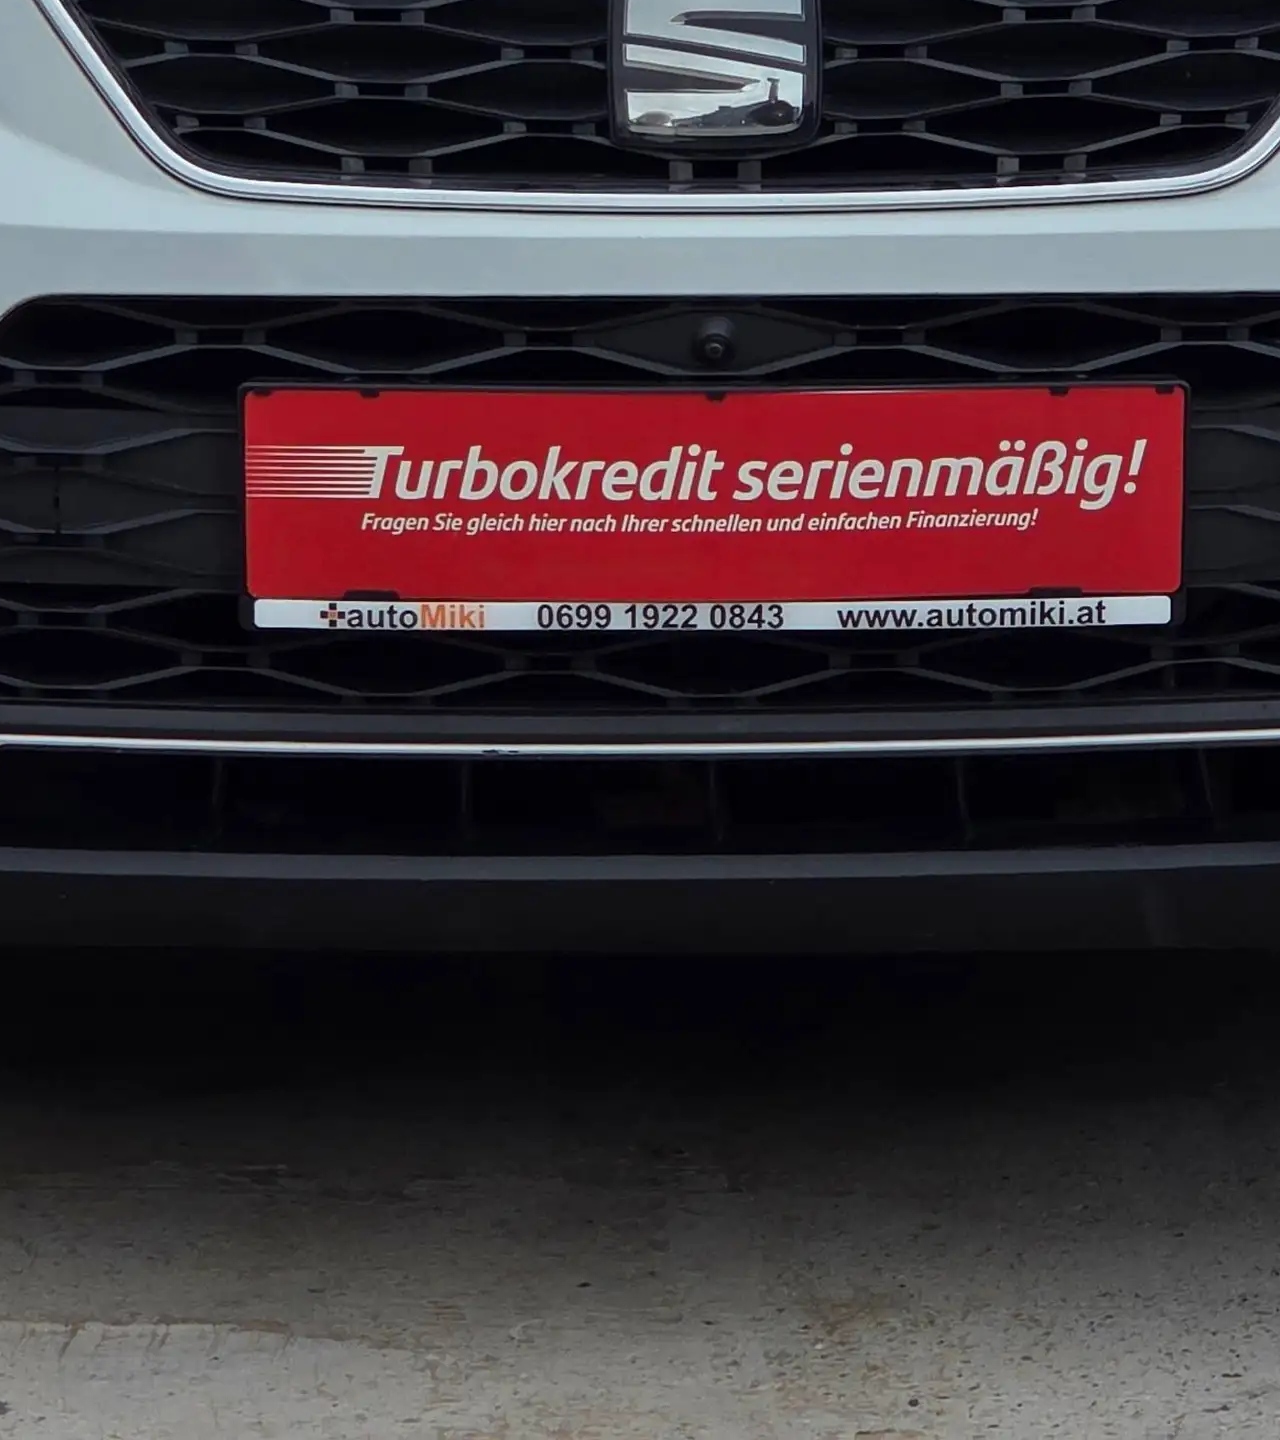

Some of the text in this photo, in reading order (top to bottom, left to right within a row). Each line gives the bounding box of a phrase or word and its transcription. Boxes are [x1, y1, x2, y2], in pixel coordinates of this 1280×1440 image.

[364, 438, 1148, 511] Turbokredit serienmäßig!
[361, 507, 1039, 536] Fragen Sie gleich hier nach Ihrer schnellen und einfachen Finanzierung!
[346, 603, 485, 629] autoMiki
[537, 603, 784, 629] 0699 1922 0843
[837, 600, 1106, 628] www.automiki.at
